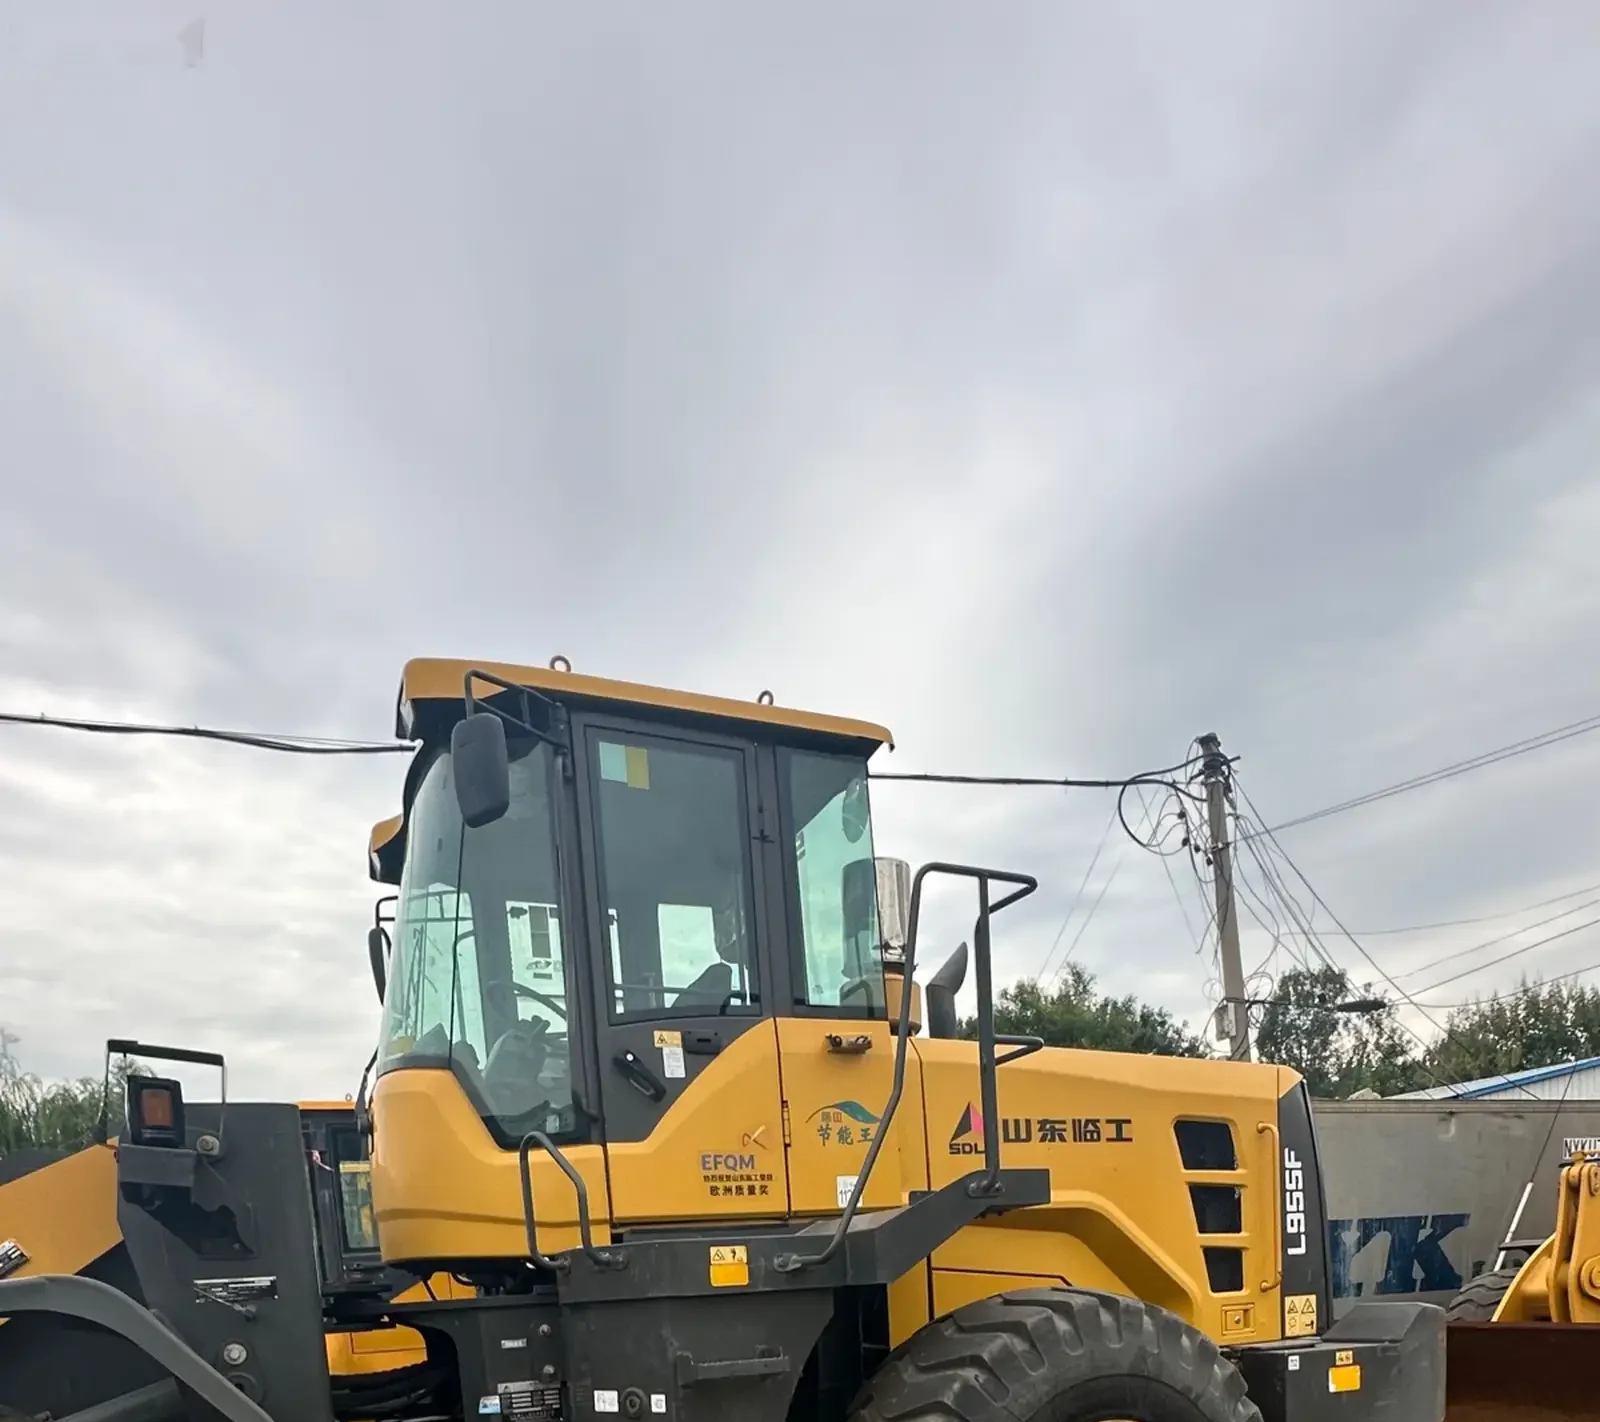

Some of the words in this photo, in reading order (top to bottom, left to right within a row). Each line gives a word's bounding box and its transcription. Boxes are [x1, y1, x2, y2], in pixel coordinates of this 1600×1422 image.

[817, 1124, 873, 1147] 节能王
[1002, 1118, 1133, 1143] 山东临工
[948, 1143, 985, 1155] SDL
[701, 1154, 755, 1172] EFQM
[709, 1185, 769, 1197] 欧洲质量奖
[1284, 1147, 1306, 1255] L955F
